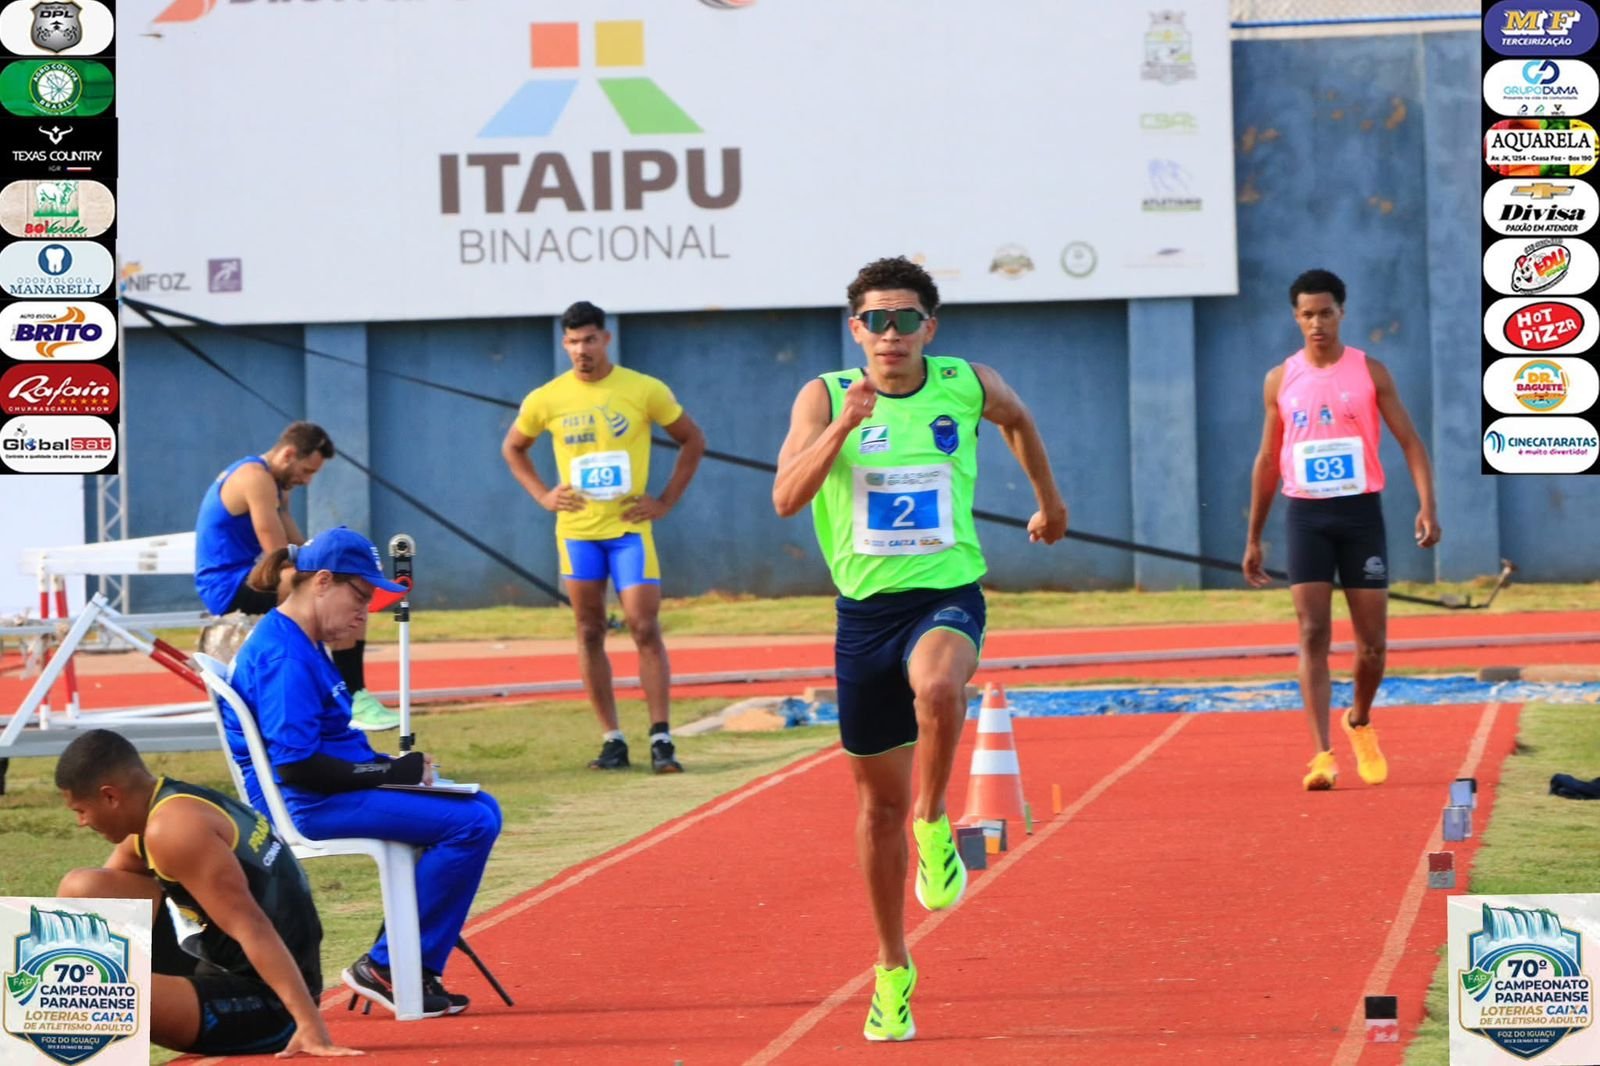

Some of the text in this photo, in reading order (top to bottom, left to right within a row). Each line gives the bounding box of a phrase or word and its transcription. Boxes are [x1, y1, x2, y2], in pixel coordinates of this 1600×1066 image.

[439, 147, 742, 215] ITAIPU
[459, 224, 731, 265] BINACIONAL
[587, 467, 614, 486] 49
[1313, 457, 1345, 480] 93
[891, 495, 915, 527] 2
